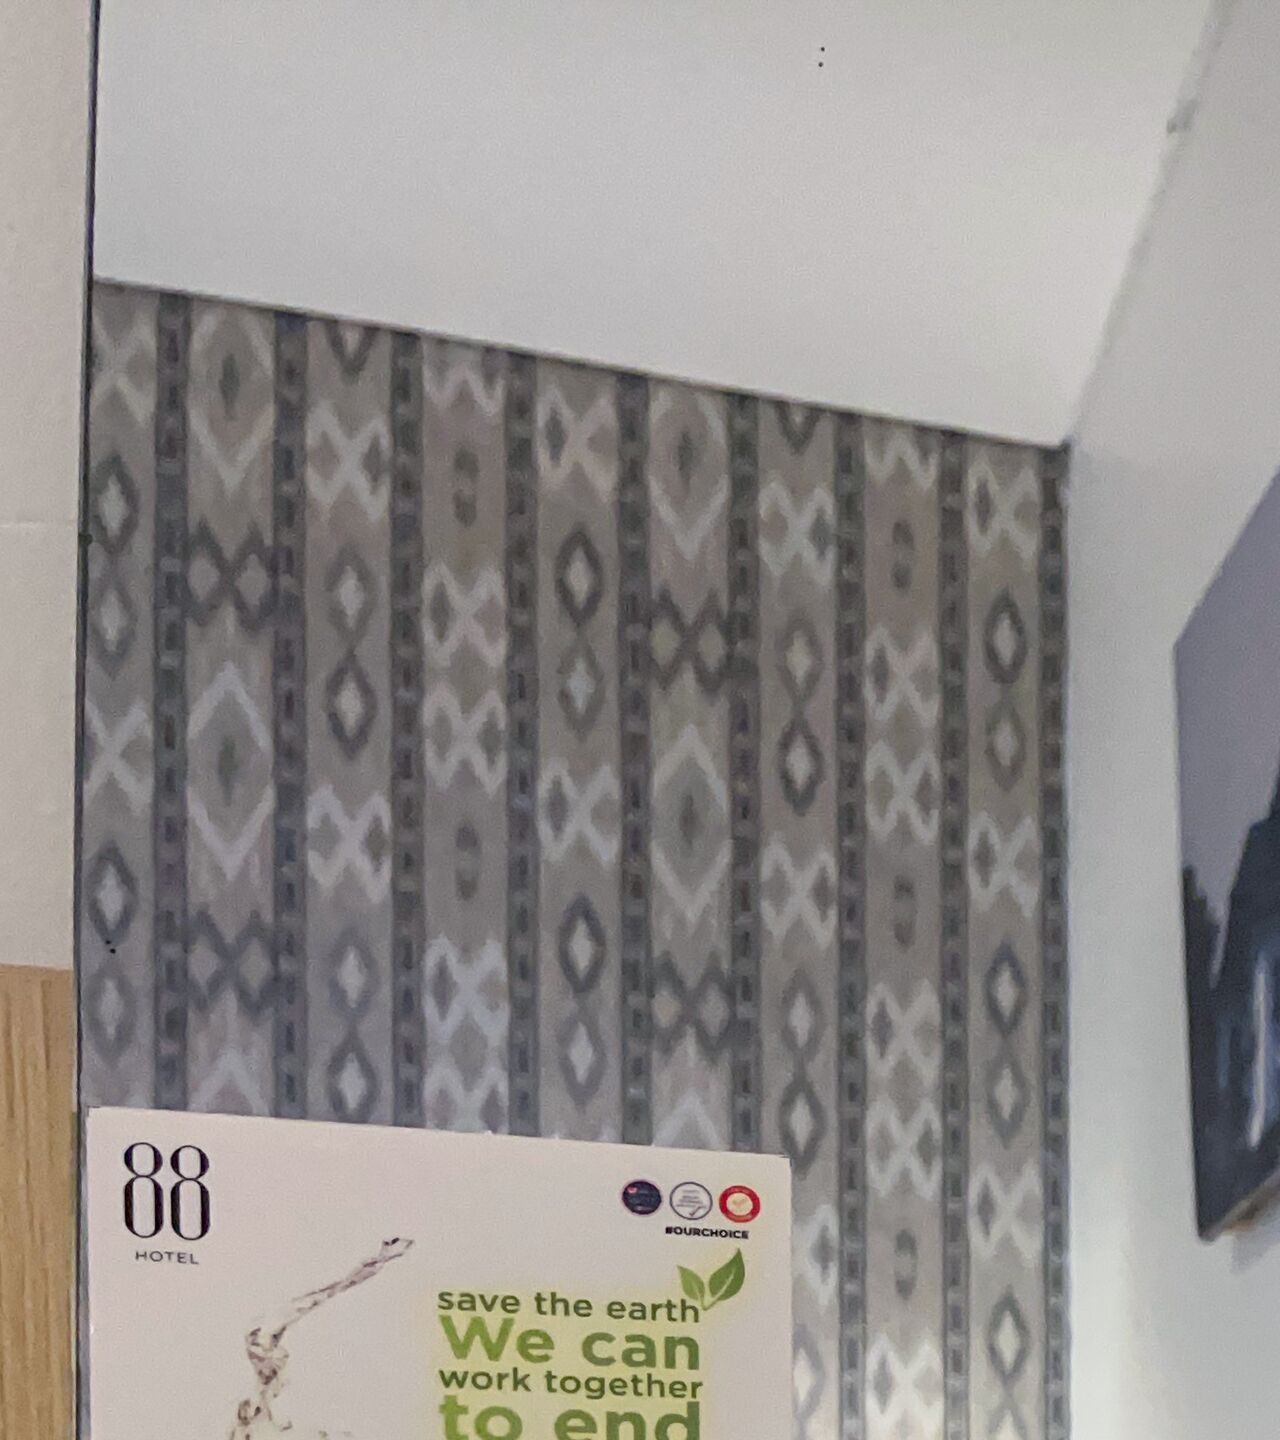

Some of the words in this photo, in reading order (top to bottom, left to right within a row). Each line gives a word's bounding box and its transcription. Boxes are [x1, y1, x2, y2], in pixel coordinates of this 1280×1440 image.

[124, 1142, 211, 1240] 88
[135, 1251, 199, 1265] HOTEL
[438, 1291, 520, 1314] save
[534, 1292, 593, 1317] the
[607, 1299, 699, 1323] earth
[439, 1314, 555, 1363] We
[581, 1332, 699, 1370] can
[439, 1367, 531, 1391] work
[545, 1370, 703, 1399] together
